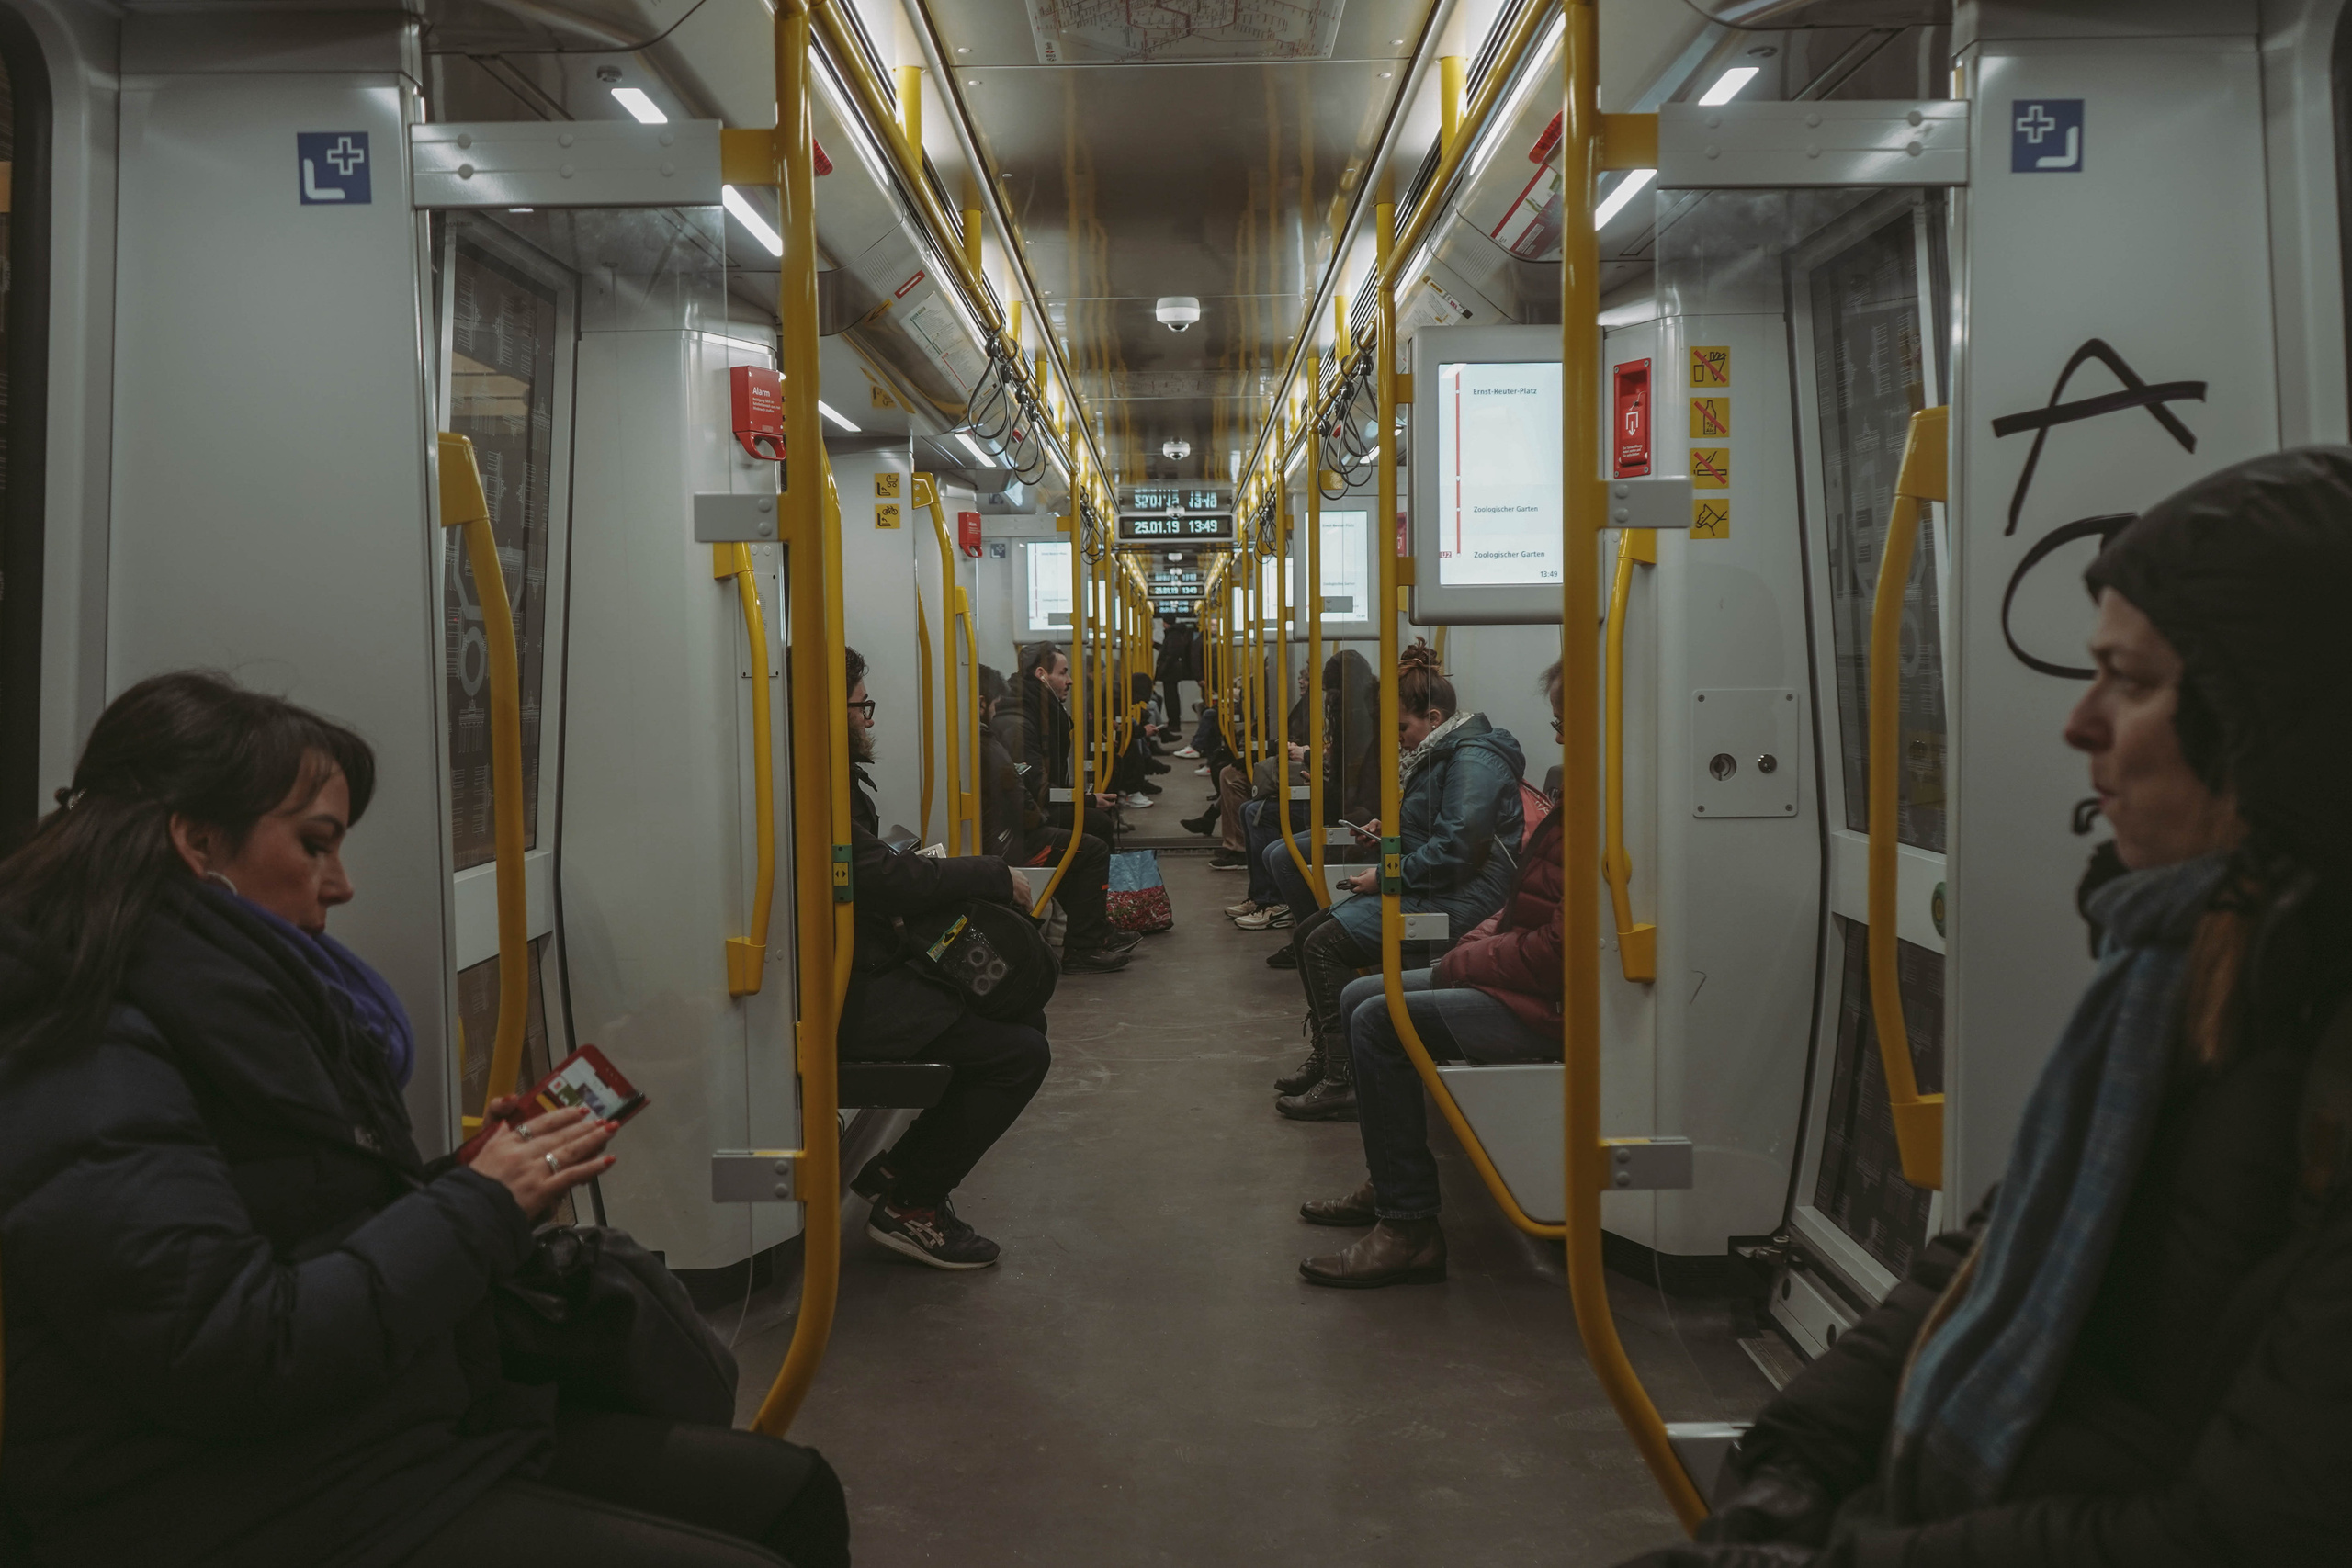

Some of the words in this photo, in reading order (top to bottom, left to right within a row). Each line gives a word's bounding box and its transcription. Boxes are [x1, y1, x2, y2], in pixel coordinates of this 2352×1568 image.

[752, 387, 770, 397] Alarm
[1134, 520, 1180, 534] 25.01.19
[1189, 519, 1217, 533] 13:49
[1474, 551, 1519, 559] Zoologischer
